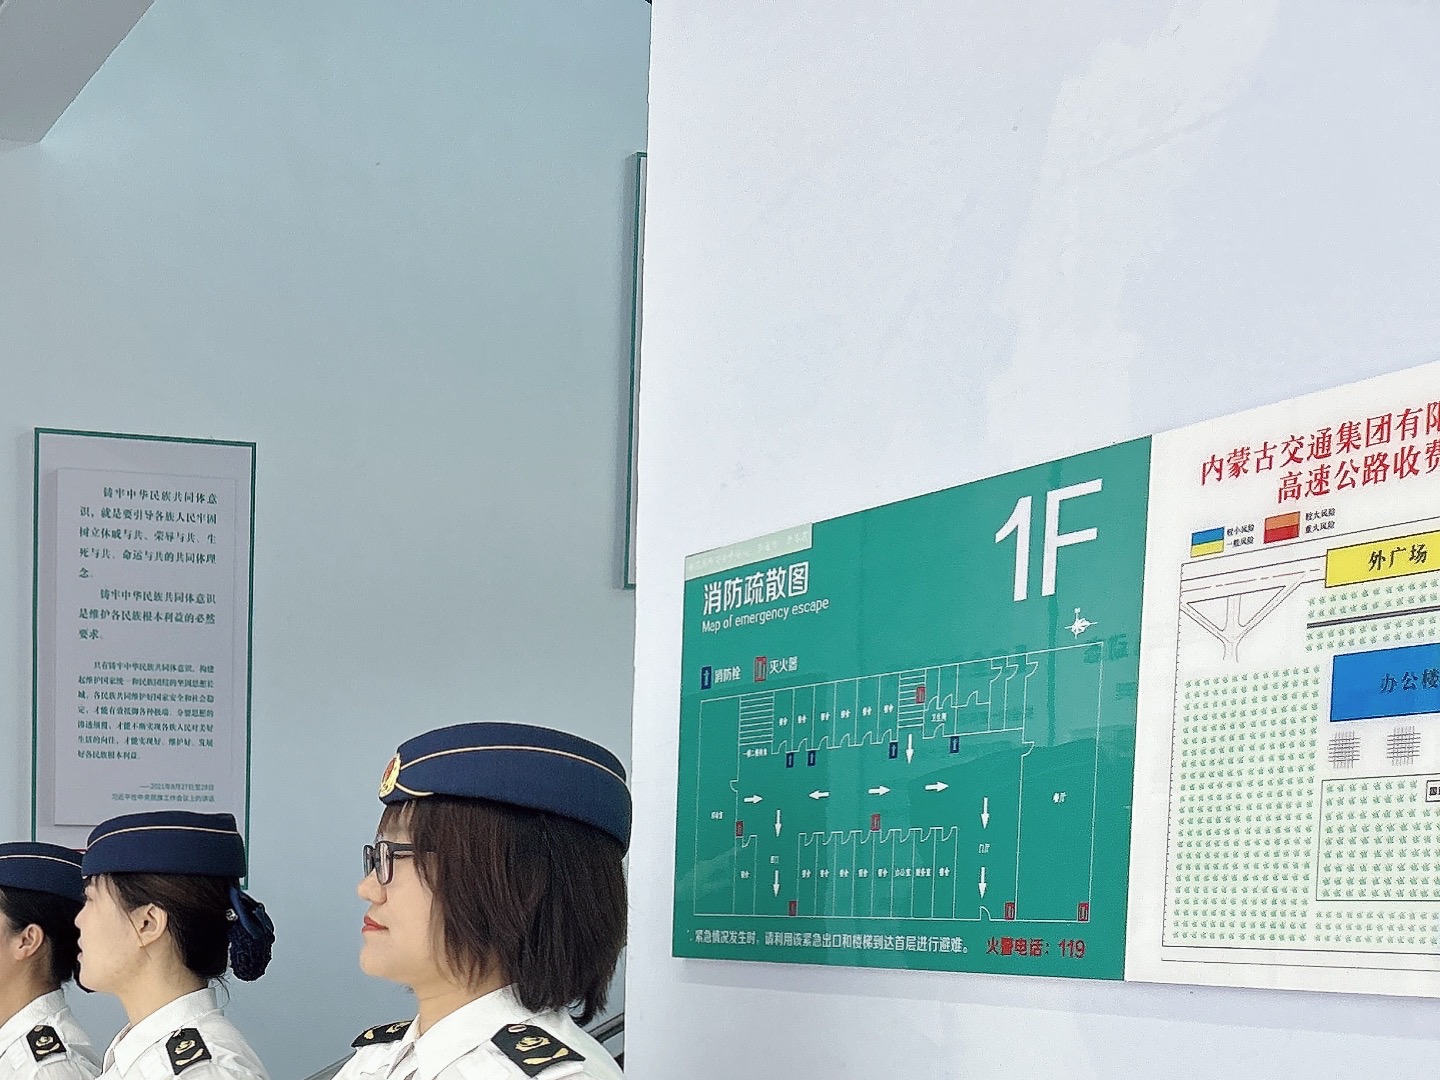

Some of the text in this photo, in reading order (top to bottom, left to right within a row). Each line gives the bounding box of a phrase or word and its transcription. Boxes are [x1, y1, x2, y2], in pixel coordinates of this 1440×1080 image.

[103, 487, 217, 504] 铸牢中华民族共同体意
[995, 478, 1103, 602] 1F
[1368, 545, 1428, 572] 外广场
[100, 589, 216, 604] 铸牢中华民族共同体意识
[702, 562, 809, 616] 消防疏散图
[79, 608, 215, 625] 是维护各民族根本利益的必然
[702, 598, 829, 633] Map of emergency escape
[715, 666, 741, 683] 消防栓
[769, 655, 798, 674] 灭火器
[1380, 668, 1440, 694] 办公楼
